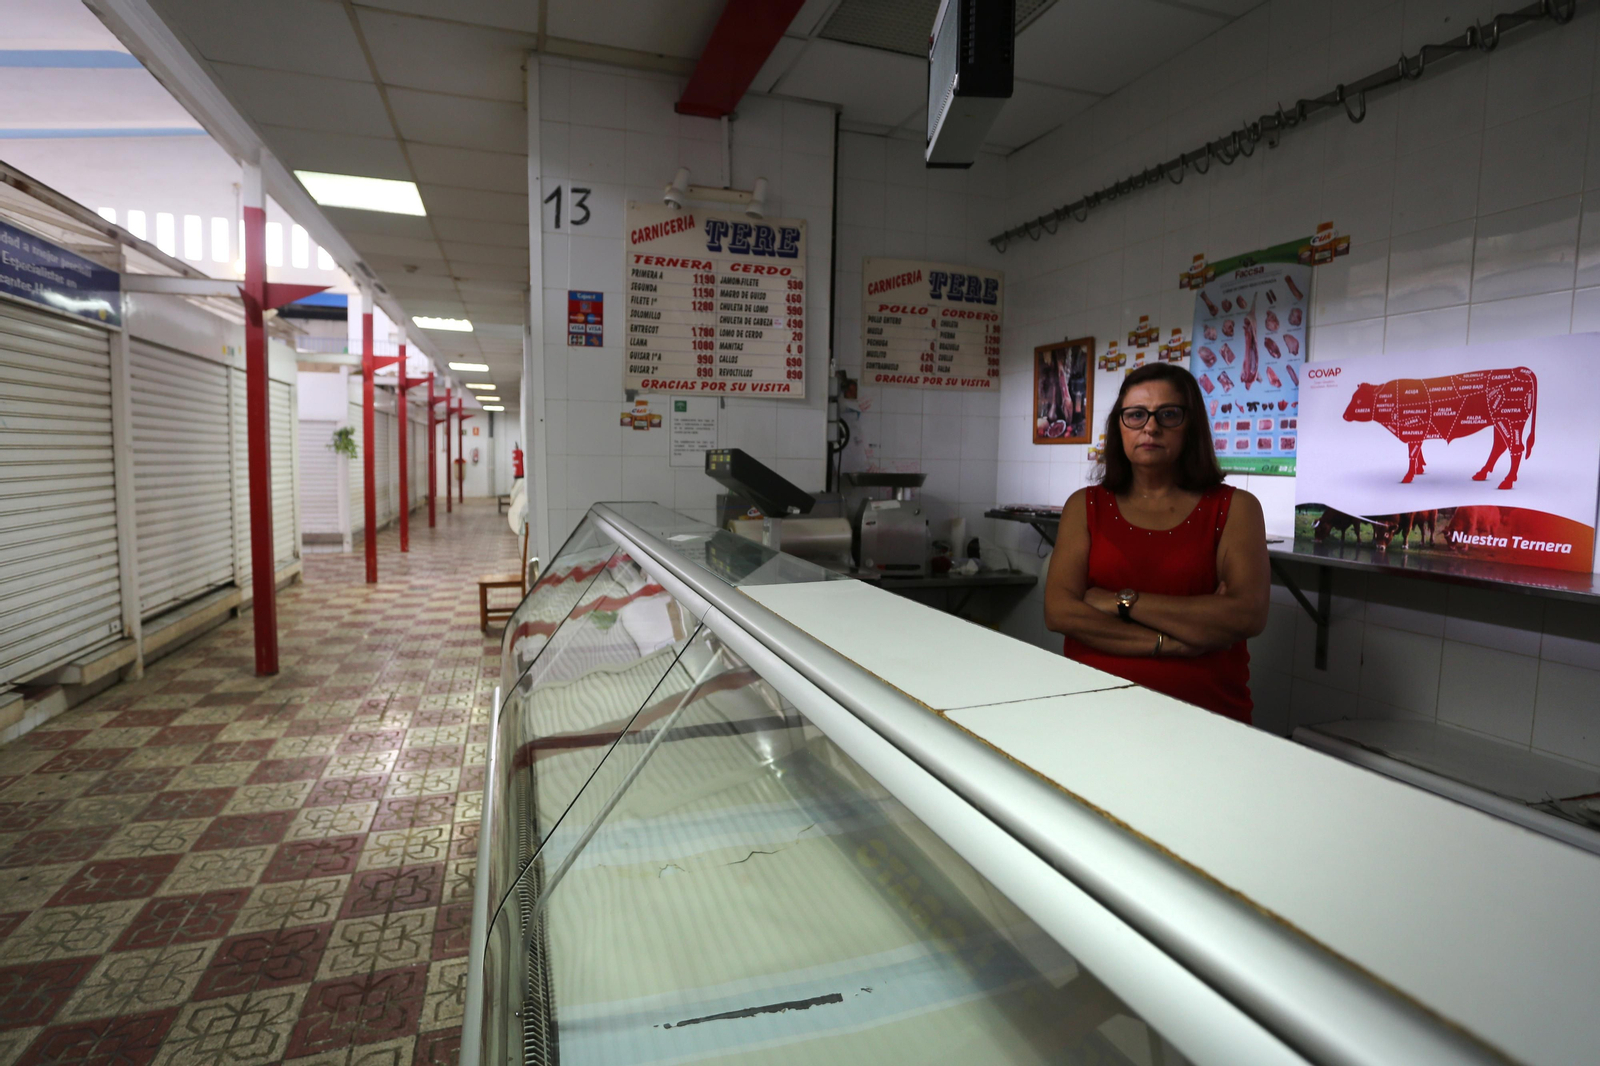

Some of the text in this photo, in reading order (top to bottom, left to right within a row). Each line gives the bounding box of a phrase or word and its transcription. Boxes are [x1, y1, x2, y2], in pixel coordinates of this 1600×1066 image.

[544, 186, 591, 229] 13
[631, 215, 695, 244] CARNICERIA
[705, 220, 800, 258] TERE
[634, 255, 713, 270] TERNERA
[631, 269, 658, 279] PRIMERA
[730, 263, 792, 276] CERDO
[1235, 266, 1264, 279] Faccsa
[694, 274, 715, 284] 1190
[868, 269, 922, 295] CARNICERIA
[631, 282, 657, 292] SEGUNDA
[788, 280, 803, 290] 530
[929, 271, 999, 305] TERE
[693, 287, 714, 298] 1150
[720, 290, 766, 300] MAGRO DE GUISO
[630, 296, 649, 305] FILETE
[786, 293, 801, 303] 460
[692, 301, 714, 311] 1280
[720, 303, 768, 313] CHULETA DE LOMO
[787, 306, 802, 315] 590
[878, 305, 928, 315] POLLO
[630, 310, 661, 320] SOLOMILLO
[942, 309, 998, 321] CORDERO
[720, 316, 743, 325] CHULETA
[753, 318, 772, 326] CABEZA
[787, 319, 803, 328] 490
[630, 324, 658, 334] ENTRECOT
[719, 330, 763, 339] LOMO DE CERDO
[630, 338, 647, 346] LLANA
[692, 340, 714, 350] 1080
[719, 342, 743, 351] MANITAS
[630, 352, 650, 361] GUISAR
[697, 354, 713, 364] 990
[786, 357, 802, 367] 690
[629, 365, 650, 374] GUISAR
[697, 367, 713, 377] 890
[1308, 368, 1342, 379] COVAP
[787, 370, 802, 380] 890
[875, 374, 990, 387] GRACIAS POR SU VISITA
[641, 380, 790, 392] GRACIAS POR SU VISITA
[1451, 531, 1572, 554] Nuestra Ternera
